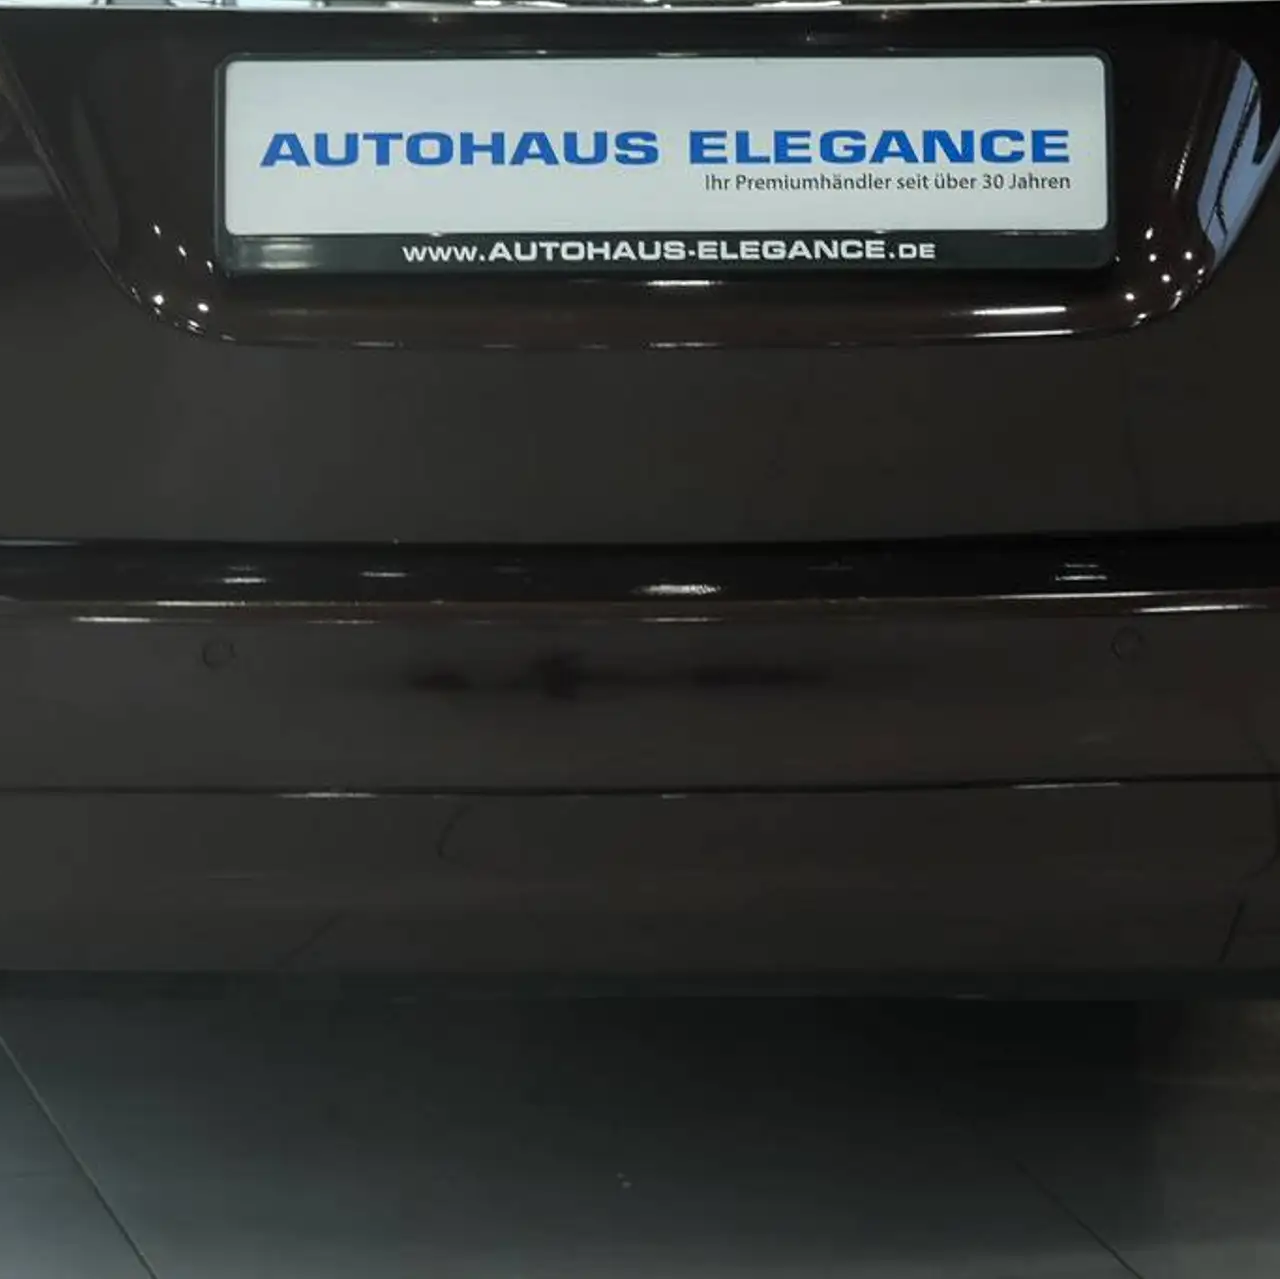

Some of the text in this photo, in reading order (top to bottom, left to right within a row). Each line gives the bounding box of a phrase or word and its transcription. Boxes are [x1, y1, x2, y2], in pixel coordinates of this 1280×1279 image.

[260, 129, 1070, 167] AUTOHAUS ELEGANCE
[705, 172, 1071, 190] Ihr Premiumhändler seit über 30 Jahren
